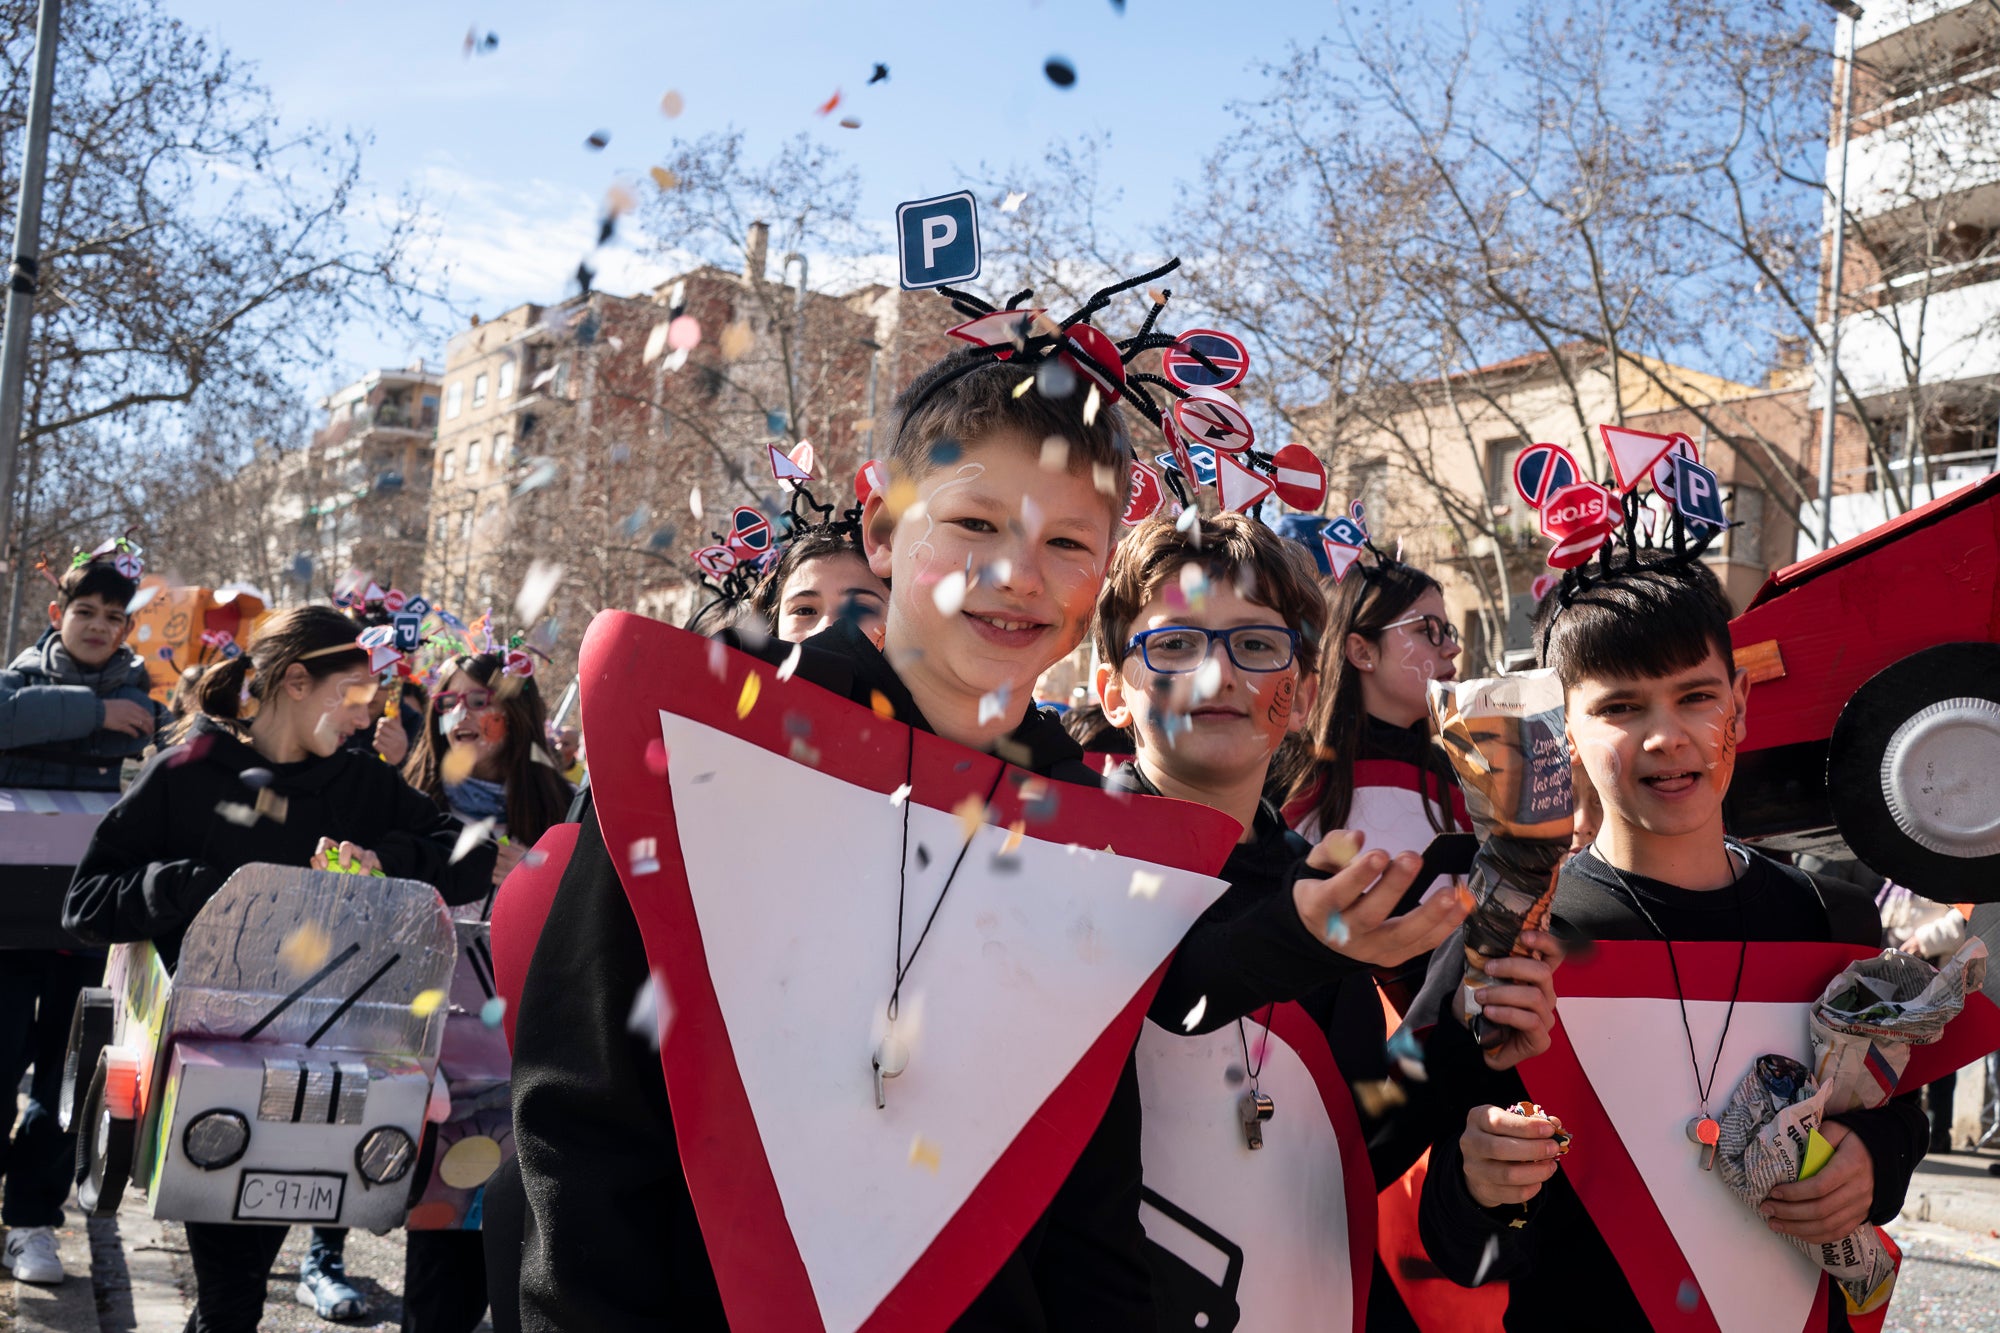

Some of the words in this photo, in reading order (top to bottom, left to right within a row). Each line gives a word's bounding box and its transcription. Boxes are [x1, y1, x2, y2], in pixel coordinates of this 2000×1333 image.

[922, 214, 958, 269] P
[1123, 469, 1146, 518] OP
[1687, 469, 1711, 508] P
[1548, 498, 1602, 525] STOP
[1332, 524, 1354, 545] P
[409, 601, 426, 614] P
[398, 624, 416, 641] P
[1773, 1132, 1783, 1149] La
